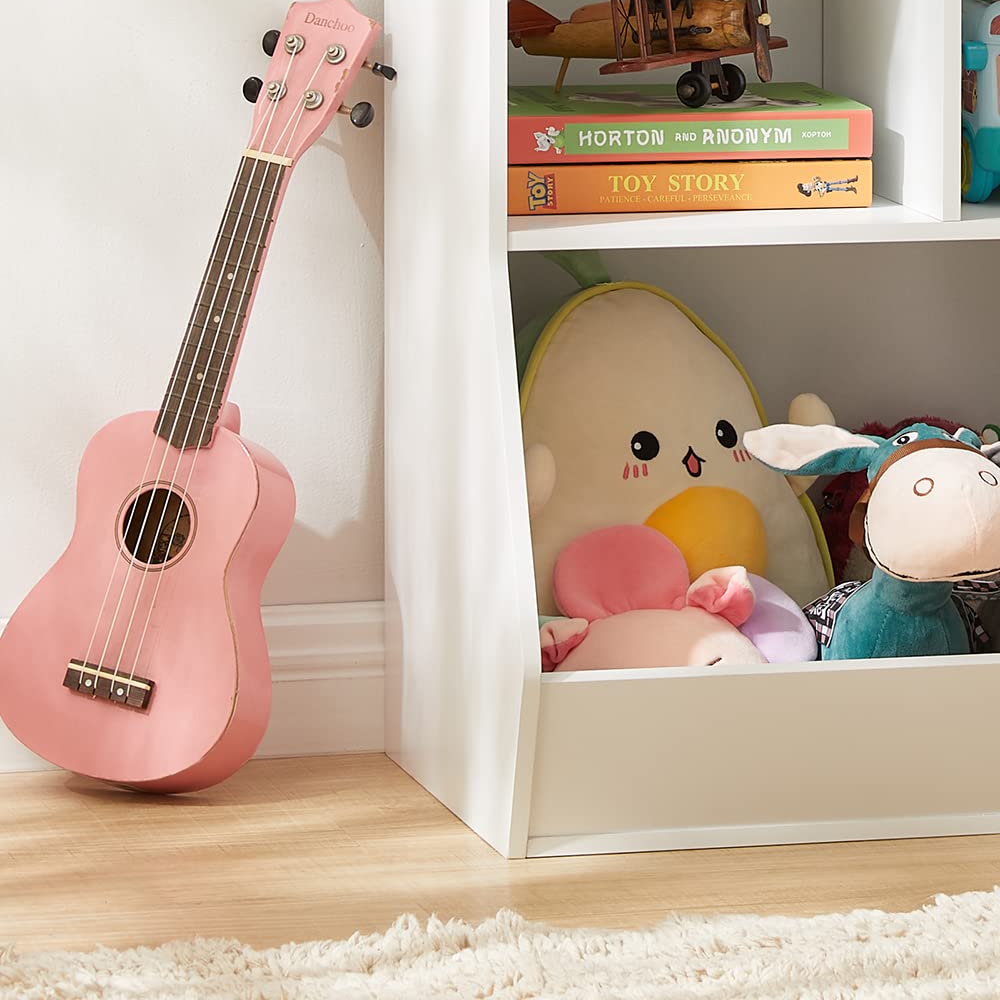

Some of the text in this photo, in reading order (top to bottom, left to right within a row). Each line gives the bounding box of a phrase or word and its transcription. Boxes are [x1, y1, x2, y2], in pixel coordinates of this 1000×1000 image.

[304, 12, 355, 32] Danchoo
[578, 129, 664, 147] HORTON
[675, 132, 697, 142] AND
[702, 127, 792, 145] ANONYM
[528, 171, 547, 210] TOY
[608, 174, 744, 192] TOY STORY
[599, 195, 641, 203] PATIENCE
[648, 194, 686, 202] CAREFUL
